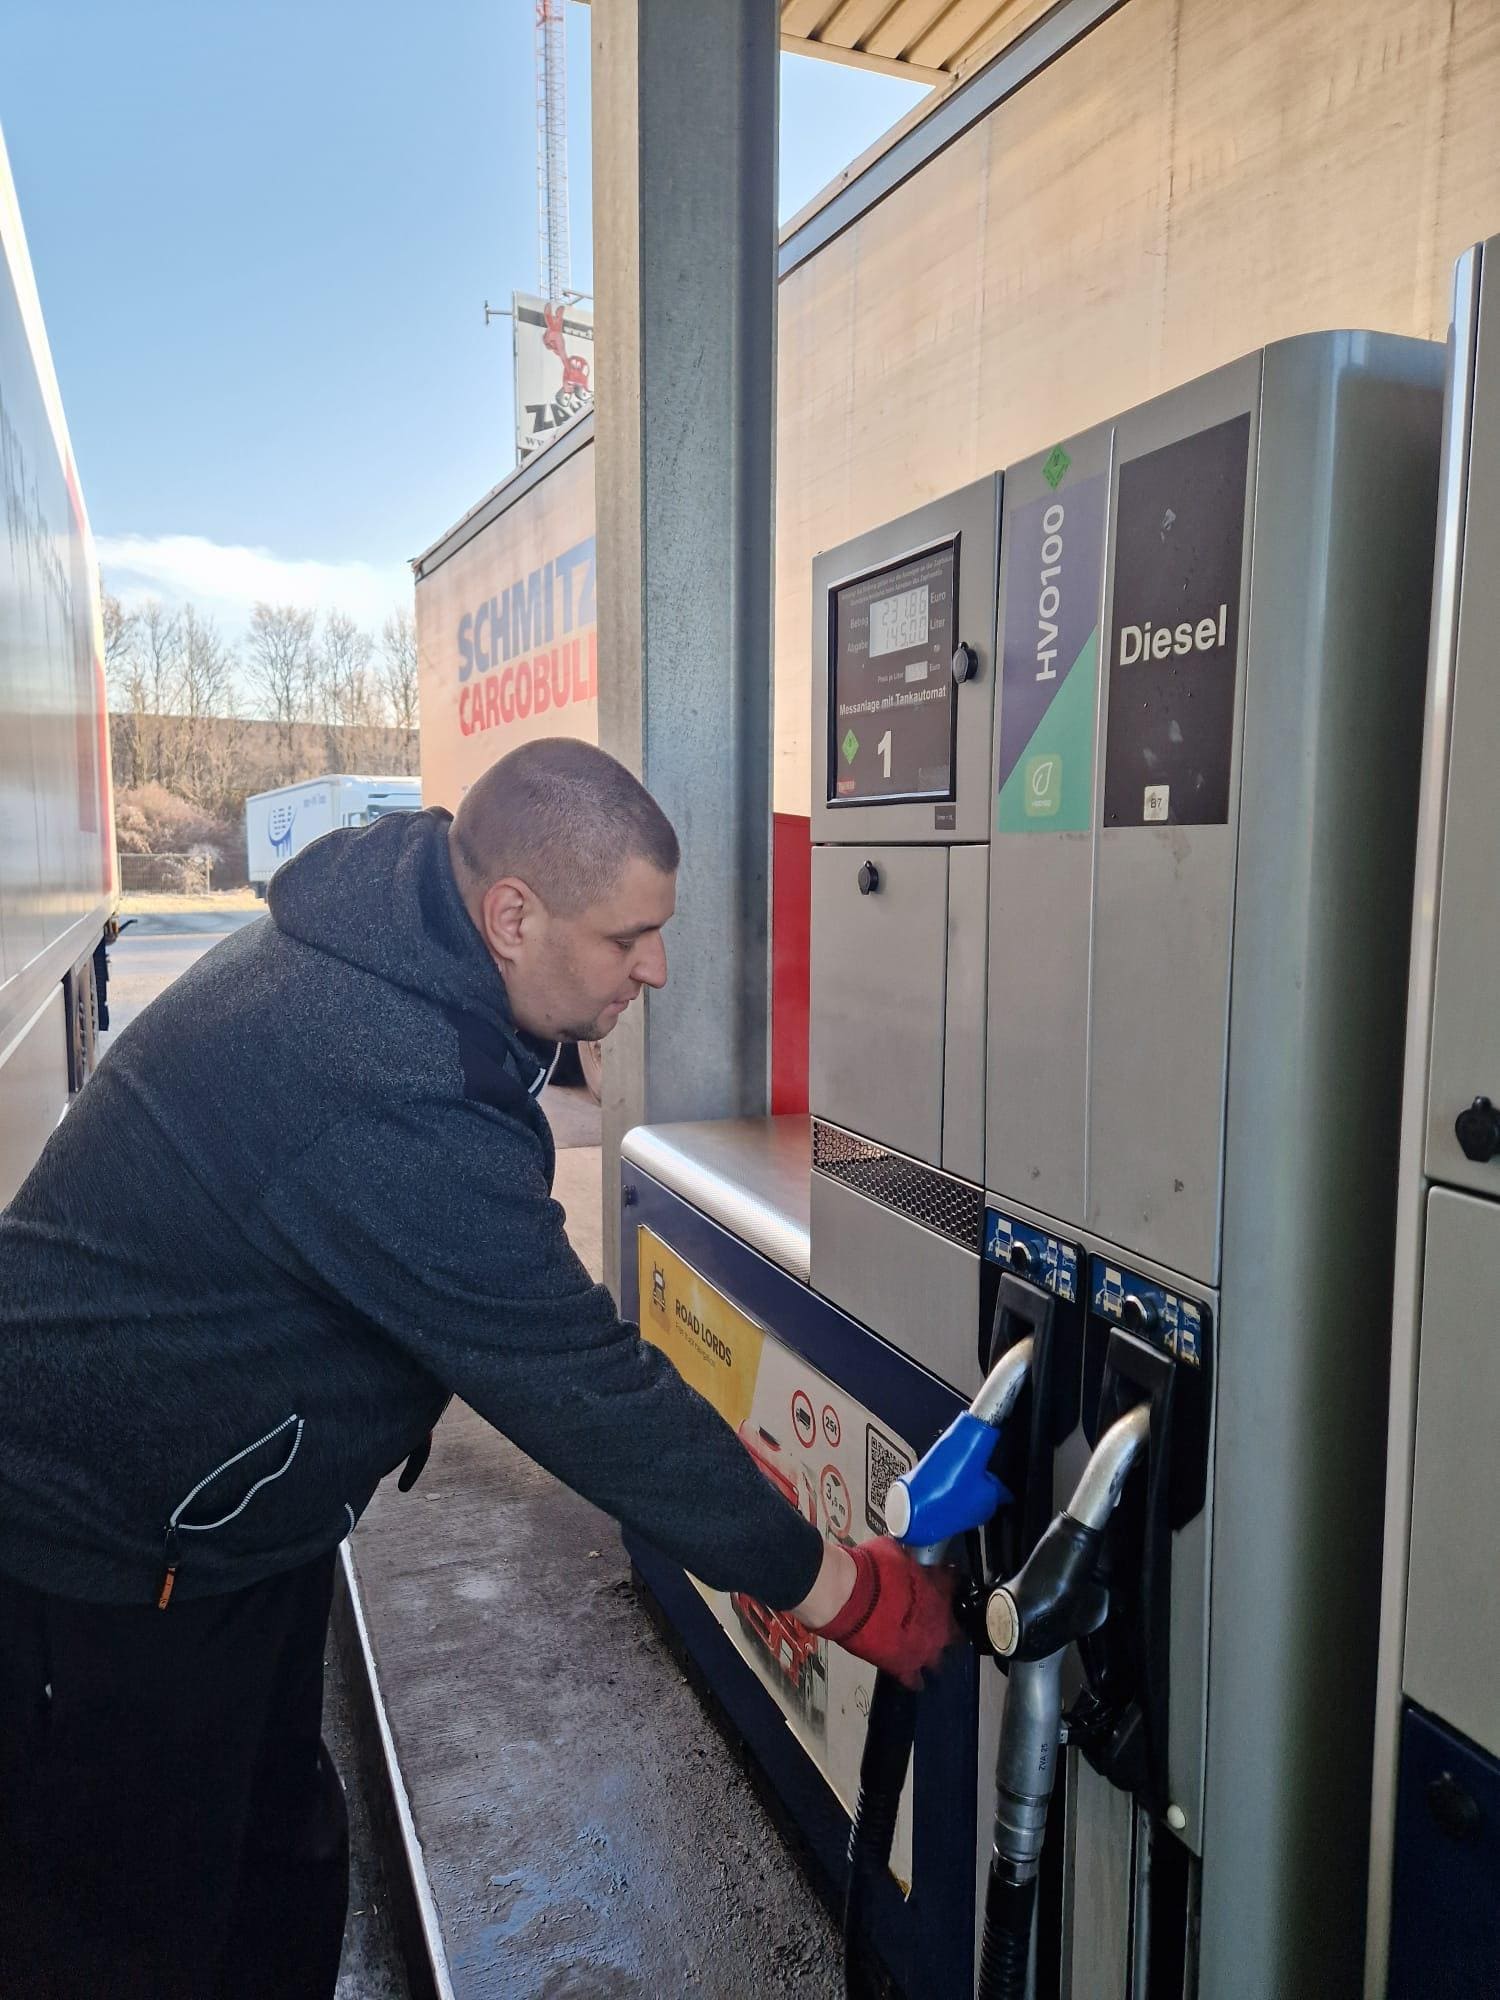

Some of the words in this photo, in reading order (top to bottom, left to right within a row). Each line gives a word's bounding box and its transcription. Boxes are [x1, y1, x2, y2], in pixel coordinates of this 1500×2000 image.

[458, 535, 596, 682] SCHMITZ
[930, 591, 946, 604] Euro
[1036, 504, 1064, 681] HVO100
[1120, 604, 1227, 666] Diesel
[840, 699, 880, 715] Messanlage
[881, 695, 893, 708] mit
[896, 685, 946, 705] Tankautomat
[877, 730, 892, 778] 1
[1151, 798, 1162, 808] B7
[676, 1299, 700, 1335] ROAD
[701, 1323, 732, 1367] LORDS
